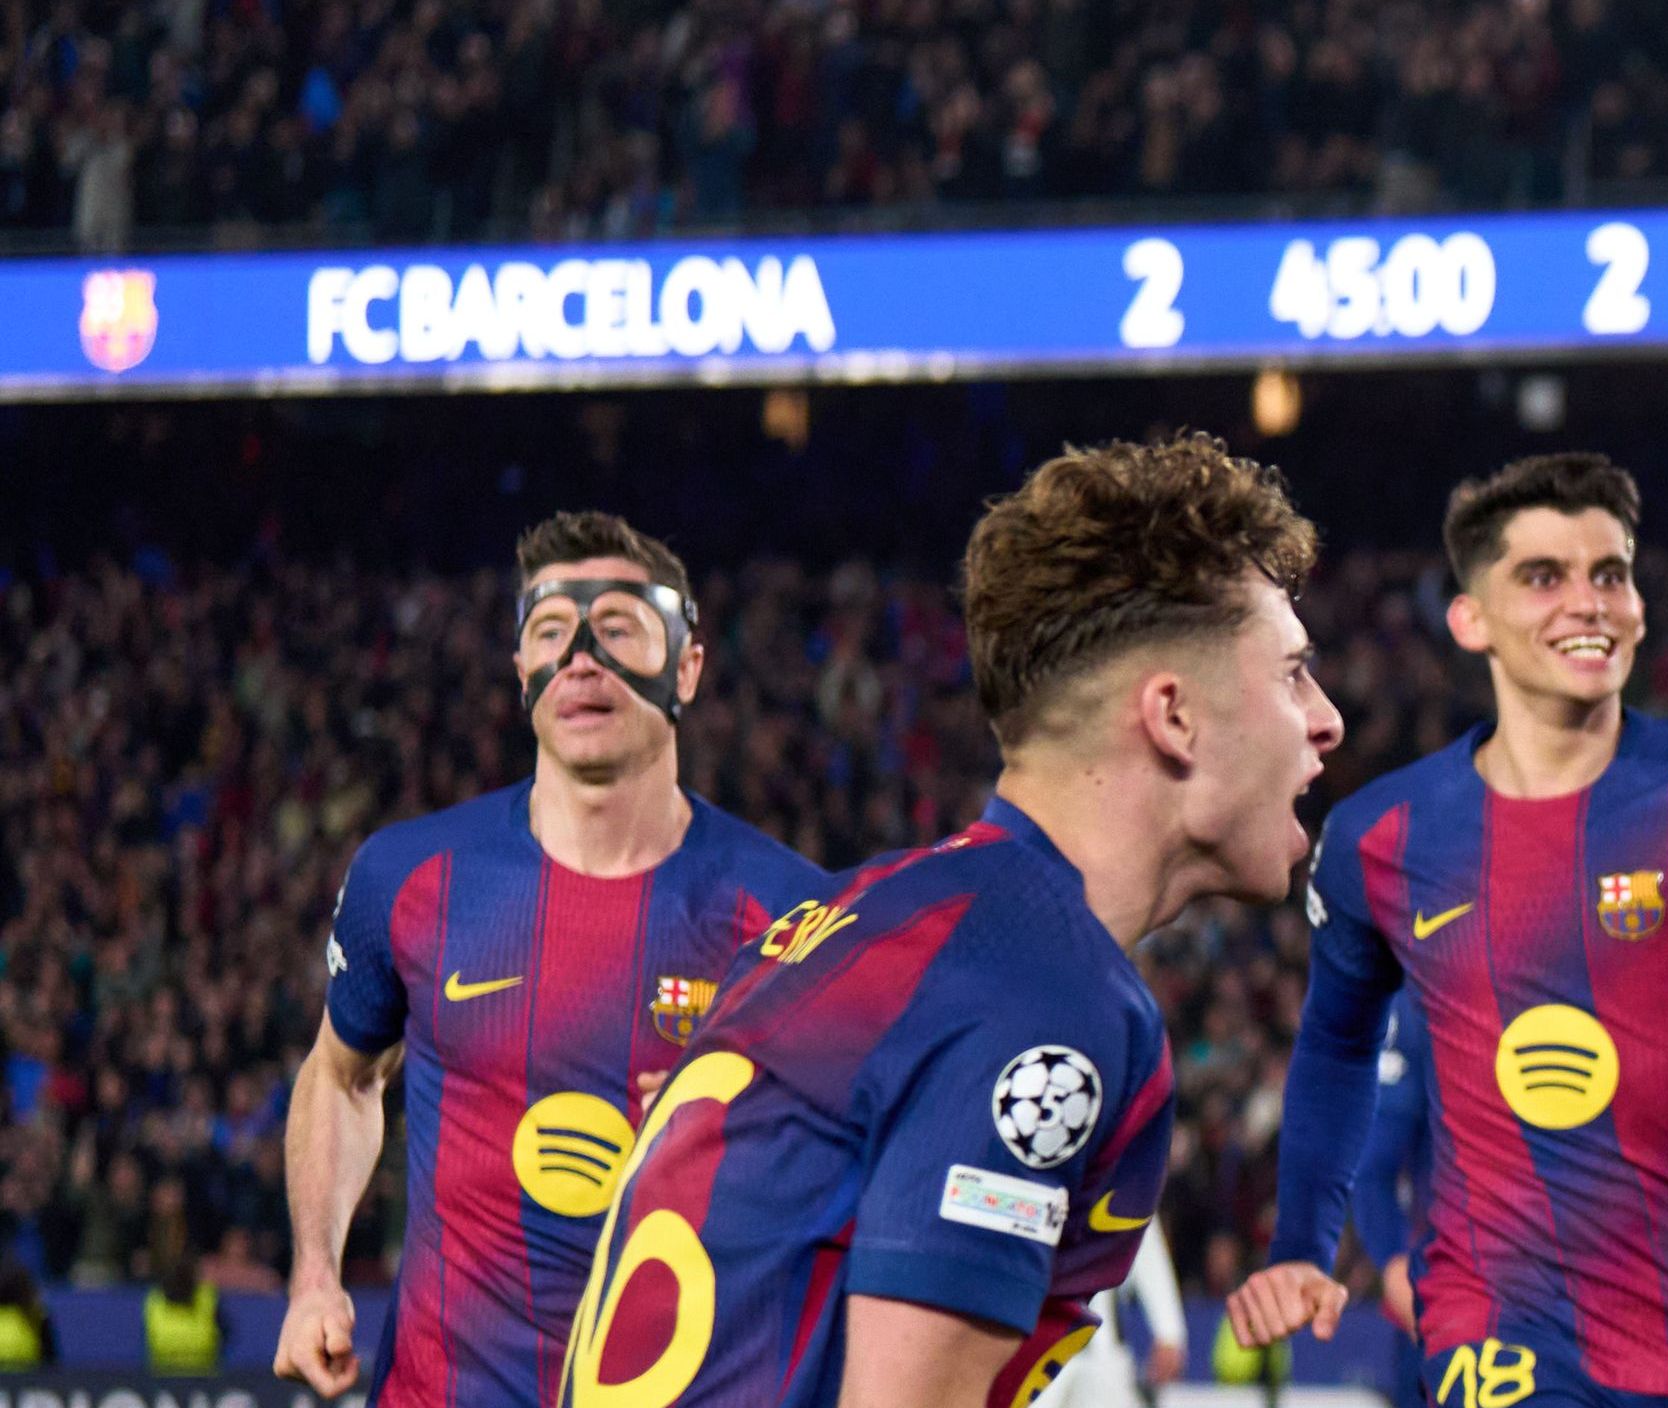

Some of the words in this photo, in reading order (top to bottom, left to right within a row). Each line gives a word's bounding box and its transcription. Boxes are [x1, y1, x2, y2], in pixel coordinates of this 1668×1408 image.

[307, 266, 398, 364] FC
[400, 256, 836, 362] BARCELONA
[1120, 238, 1185, 348] 2
[1269, 233, 1496, 340] 45:00
[1583, 222, 1650, 335] 2
